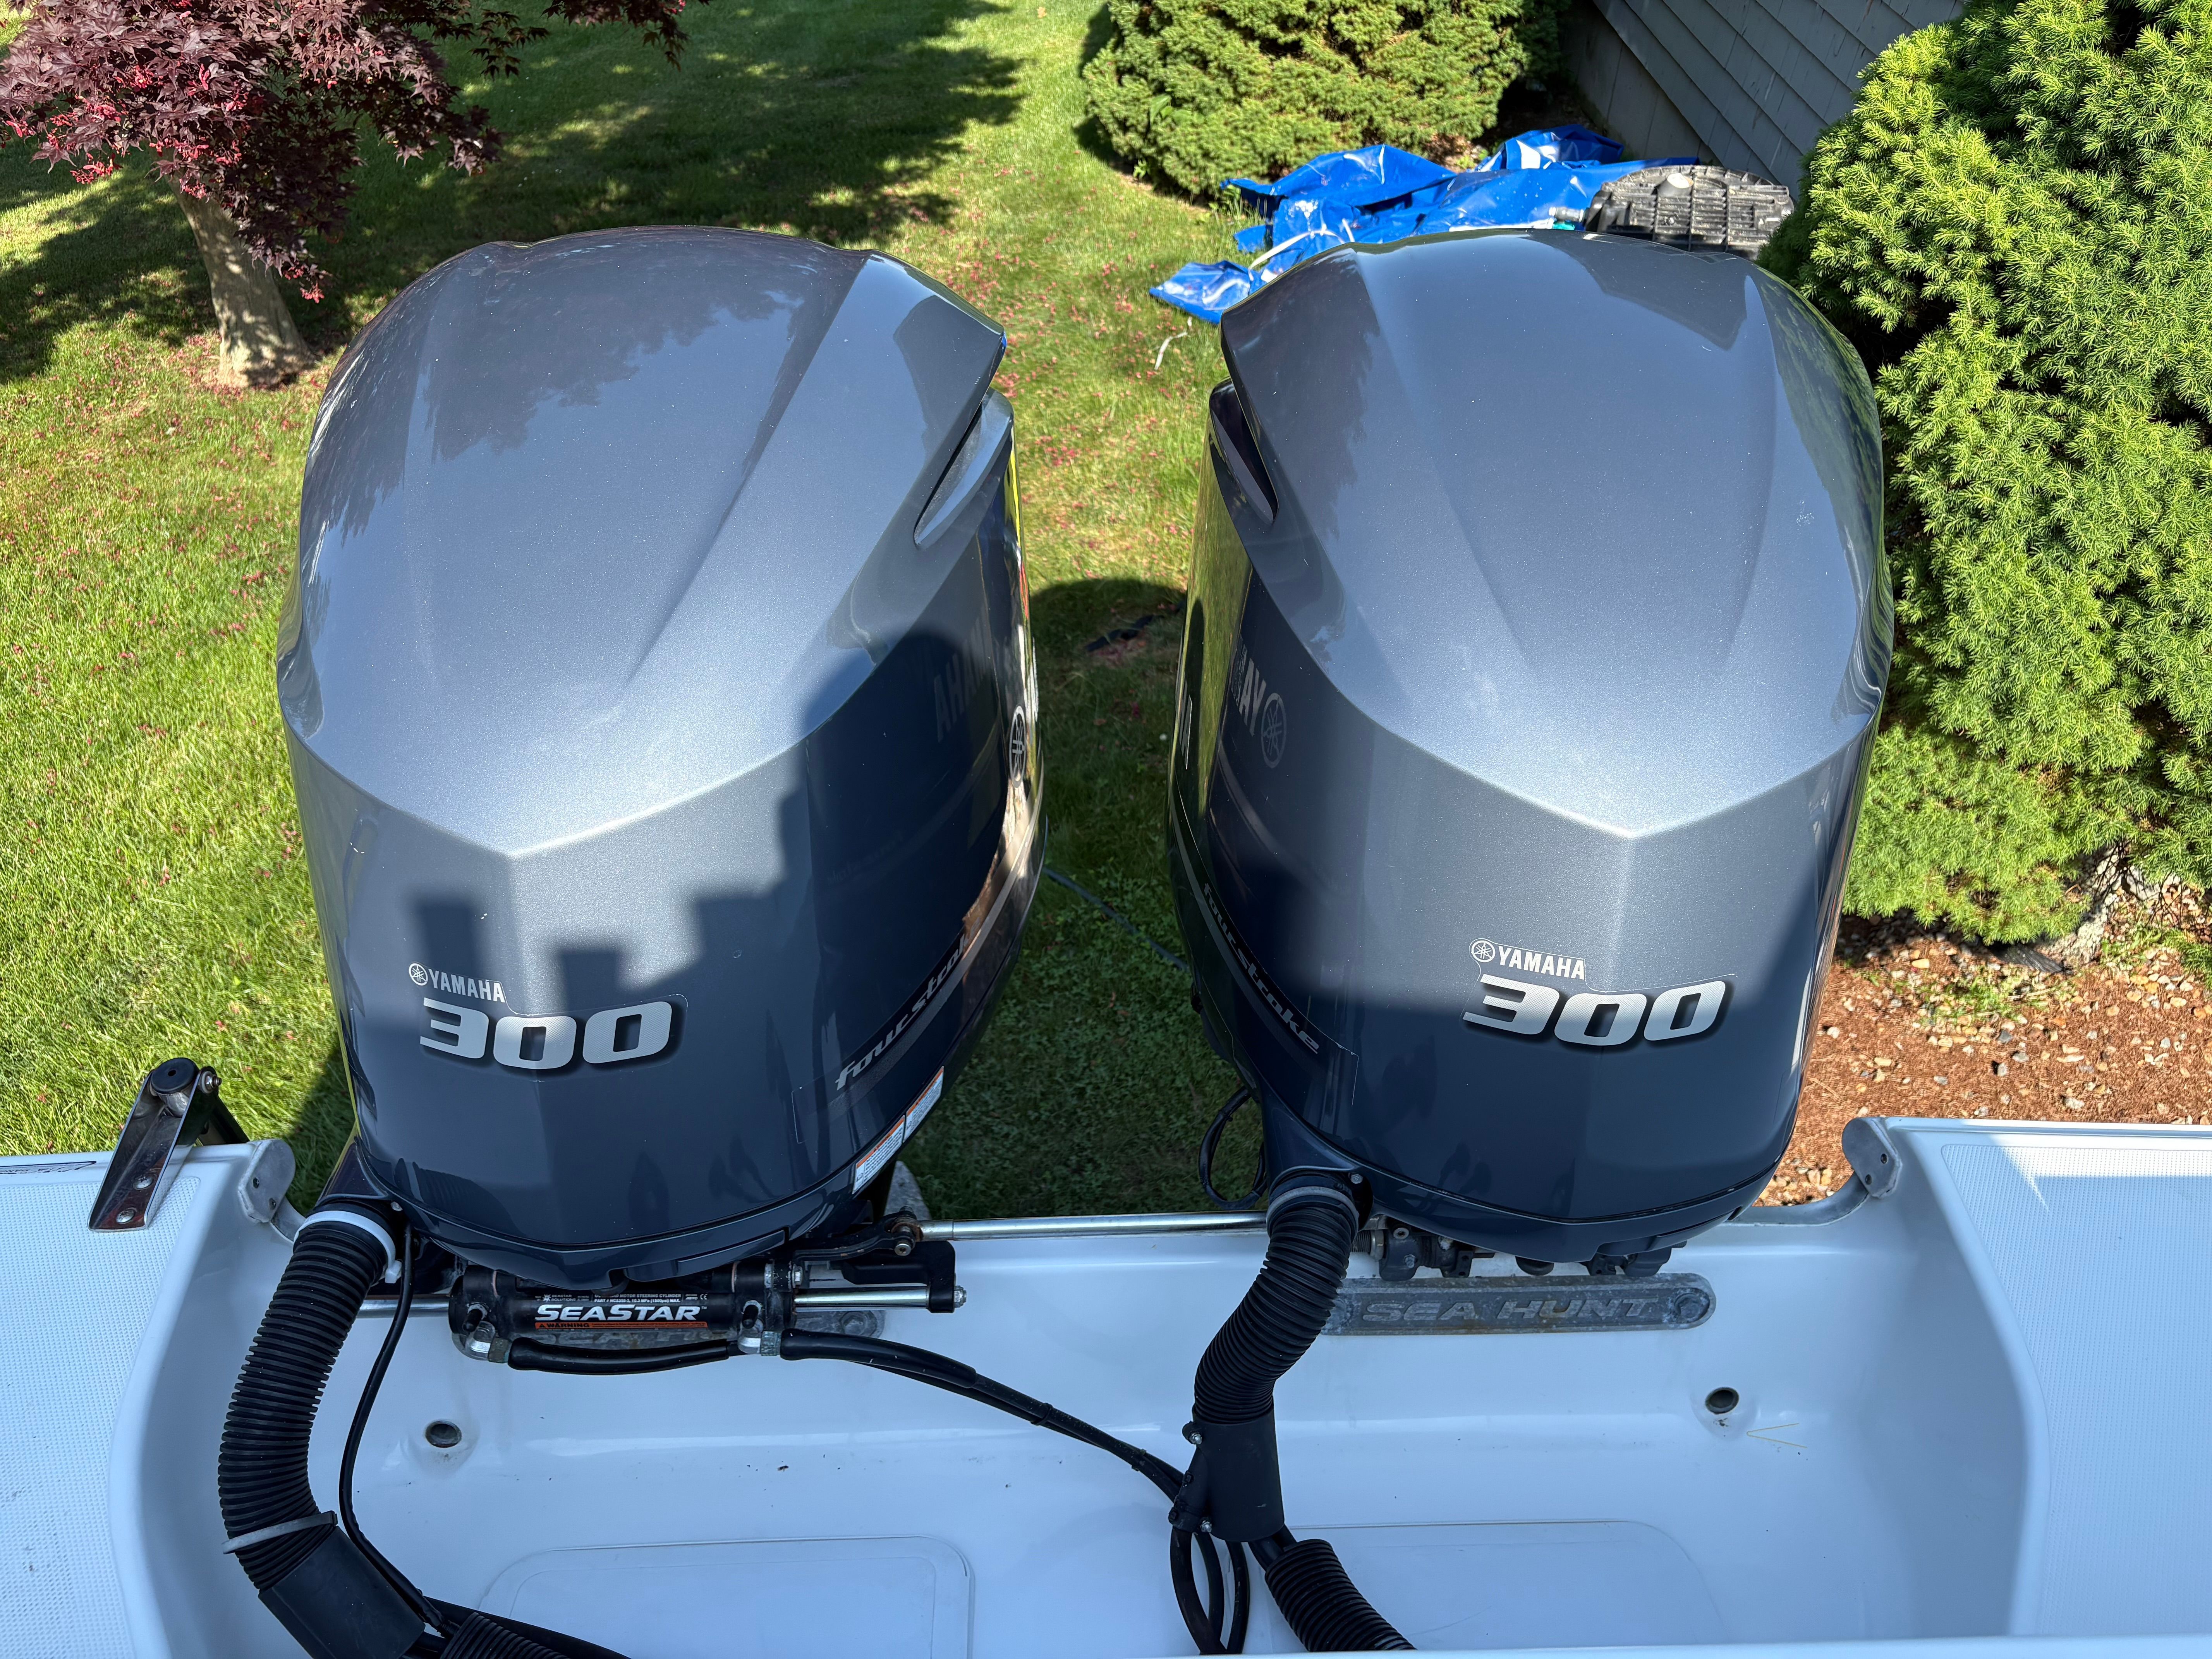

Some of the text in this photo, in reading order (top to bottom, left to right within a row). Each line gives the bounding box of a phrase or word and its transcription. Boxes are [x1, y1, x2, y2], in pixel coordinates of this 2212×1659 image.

[1499, 946, 1585, 980] YAMAHA
[428, 969, 506, 1003] YAMAHA
[1463, 974, 1726, 1046] 300
[420, 998, 672, 1070] 300
[535, 1304, 701, 1321] SEASTAR
[1362, 1298, 1659, 1321] SEA HUNT
